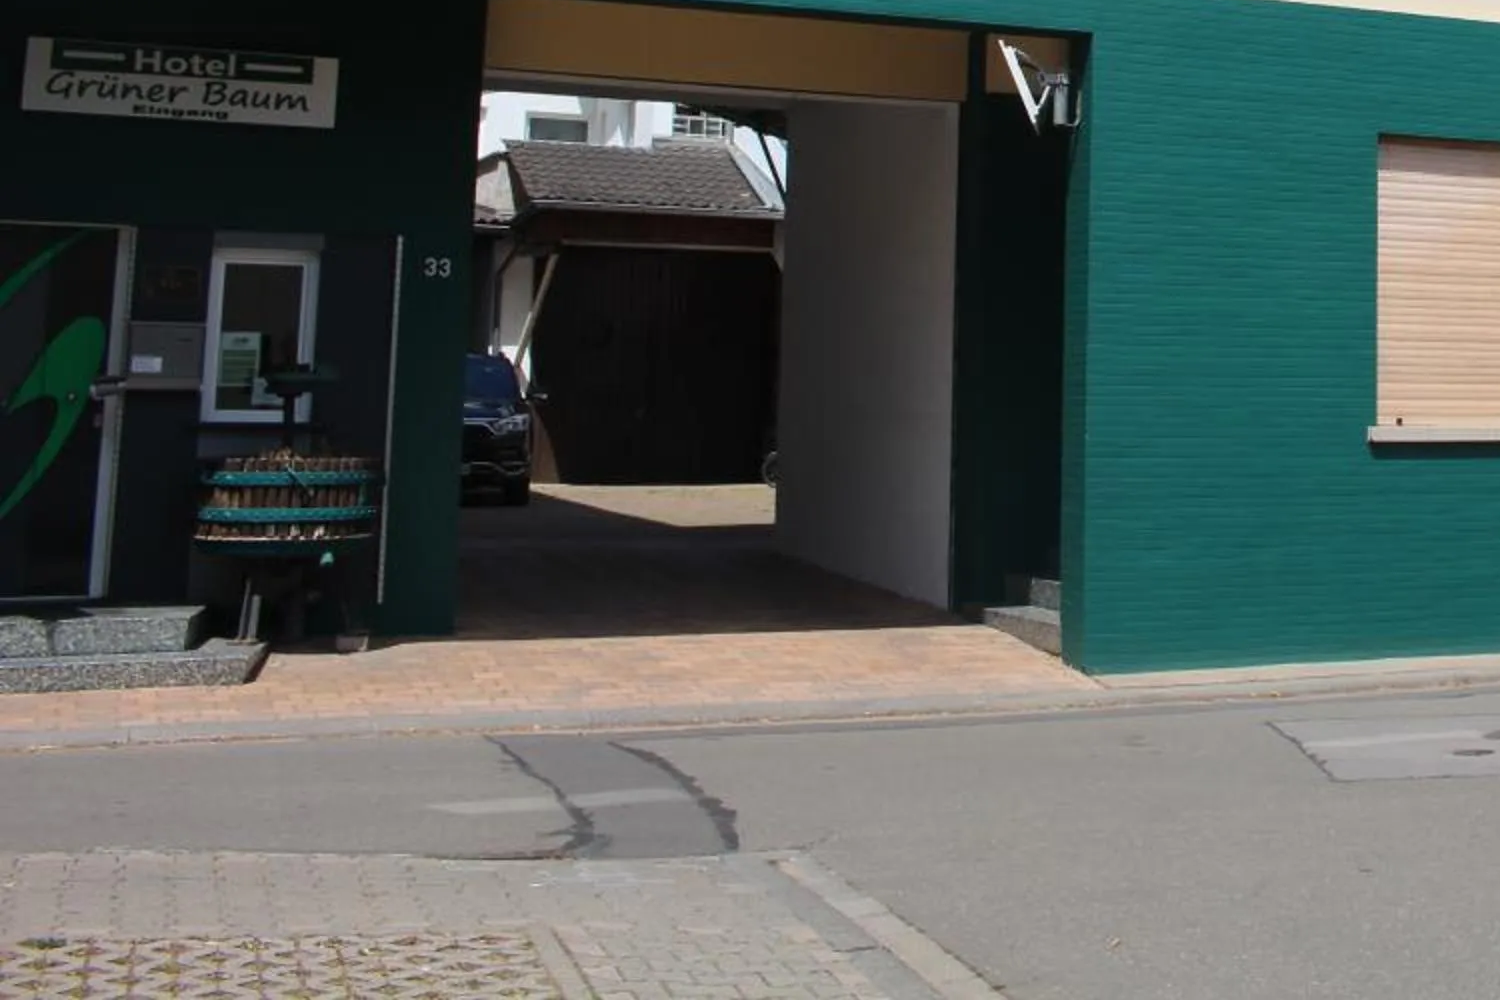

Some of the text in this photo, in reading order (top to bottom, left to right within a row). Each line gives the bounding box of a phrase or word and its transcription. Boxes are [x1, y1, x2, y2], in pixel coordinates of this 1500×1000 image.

[133, 48, 237, 77] Hotel
[44, 71, 311, 112] Grüner Baum
[132, 104, 230, 120] Eingang
[424, 257, 451, 278] 33
